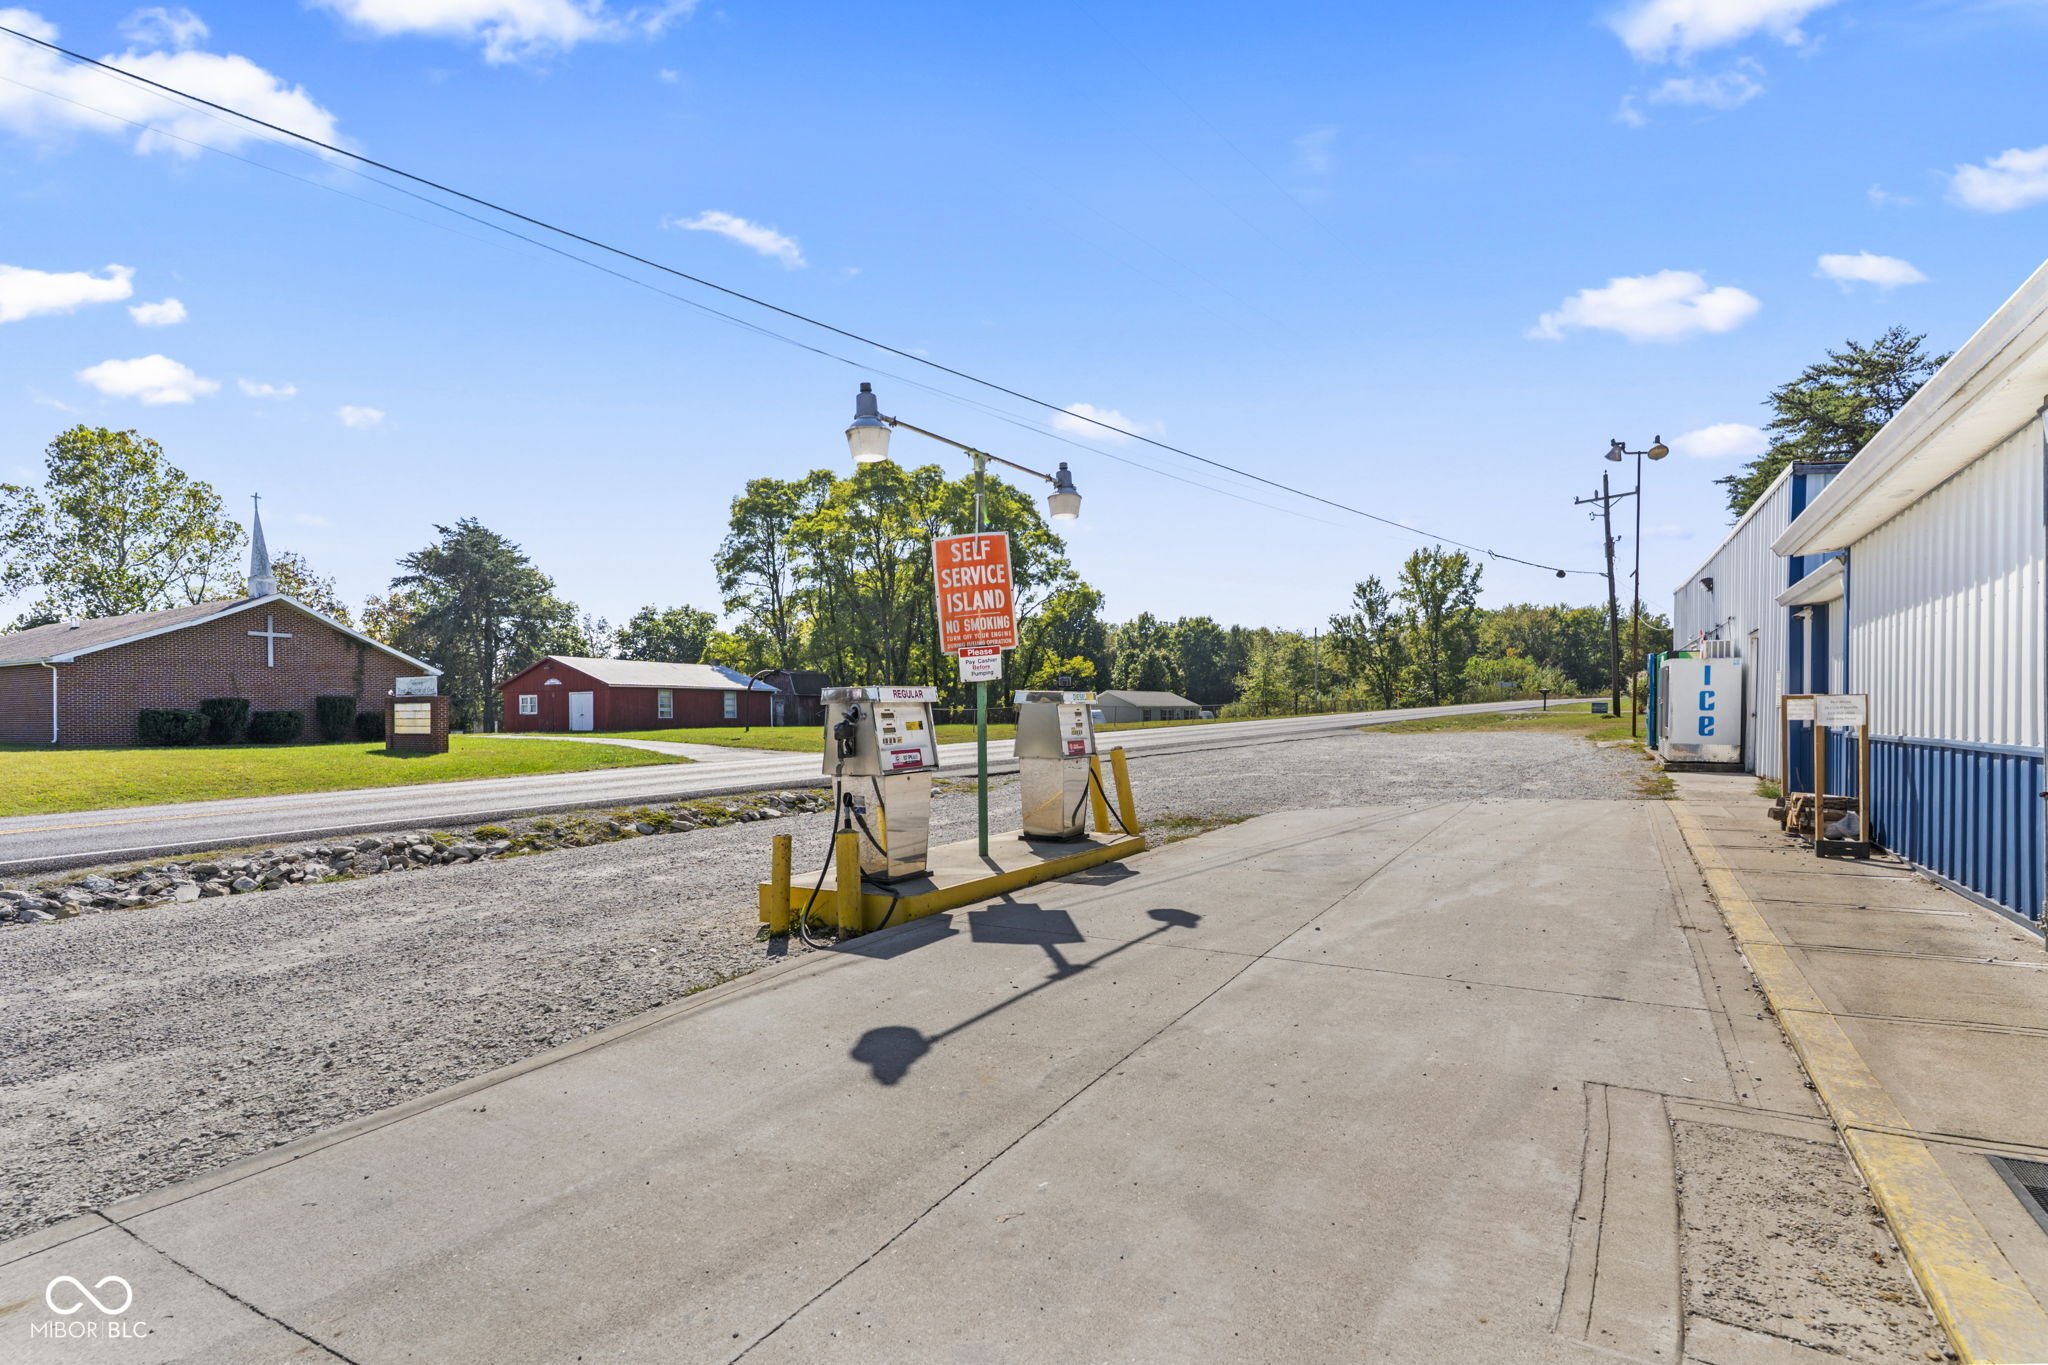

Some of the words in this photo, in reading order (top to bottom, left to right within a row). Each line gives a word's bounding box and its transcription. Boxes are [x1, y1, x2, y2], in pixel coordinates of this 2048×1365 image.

[950, 540, 990, 562] SELF
[941, 565, 1006, 588] SERVICE
[946, 589, 1005, 613] ISLAND
[945, 620, 960, 634] NO
[964, 615, 1010, 631] SMOKING
[967, 648, 993, 656] Please
[892, 689, 924, 699] REGULAR
